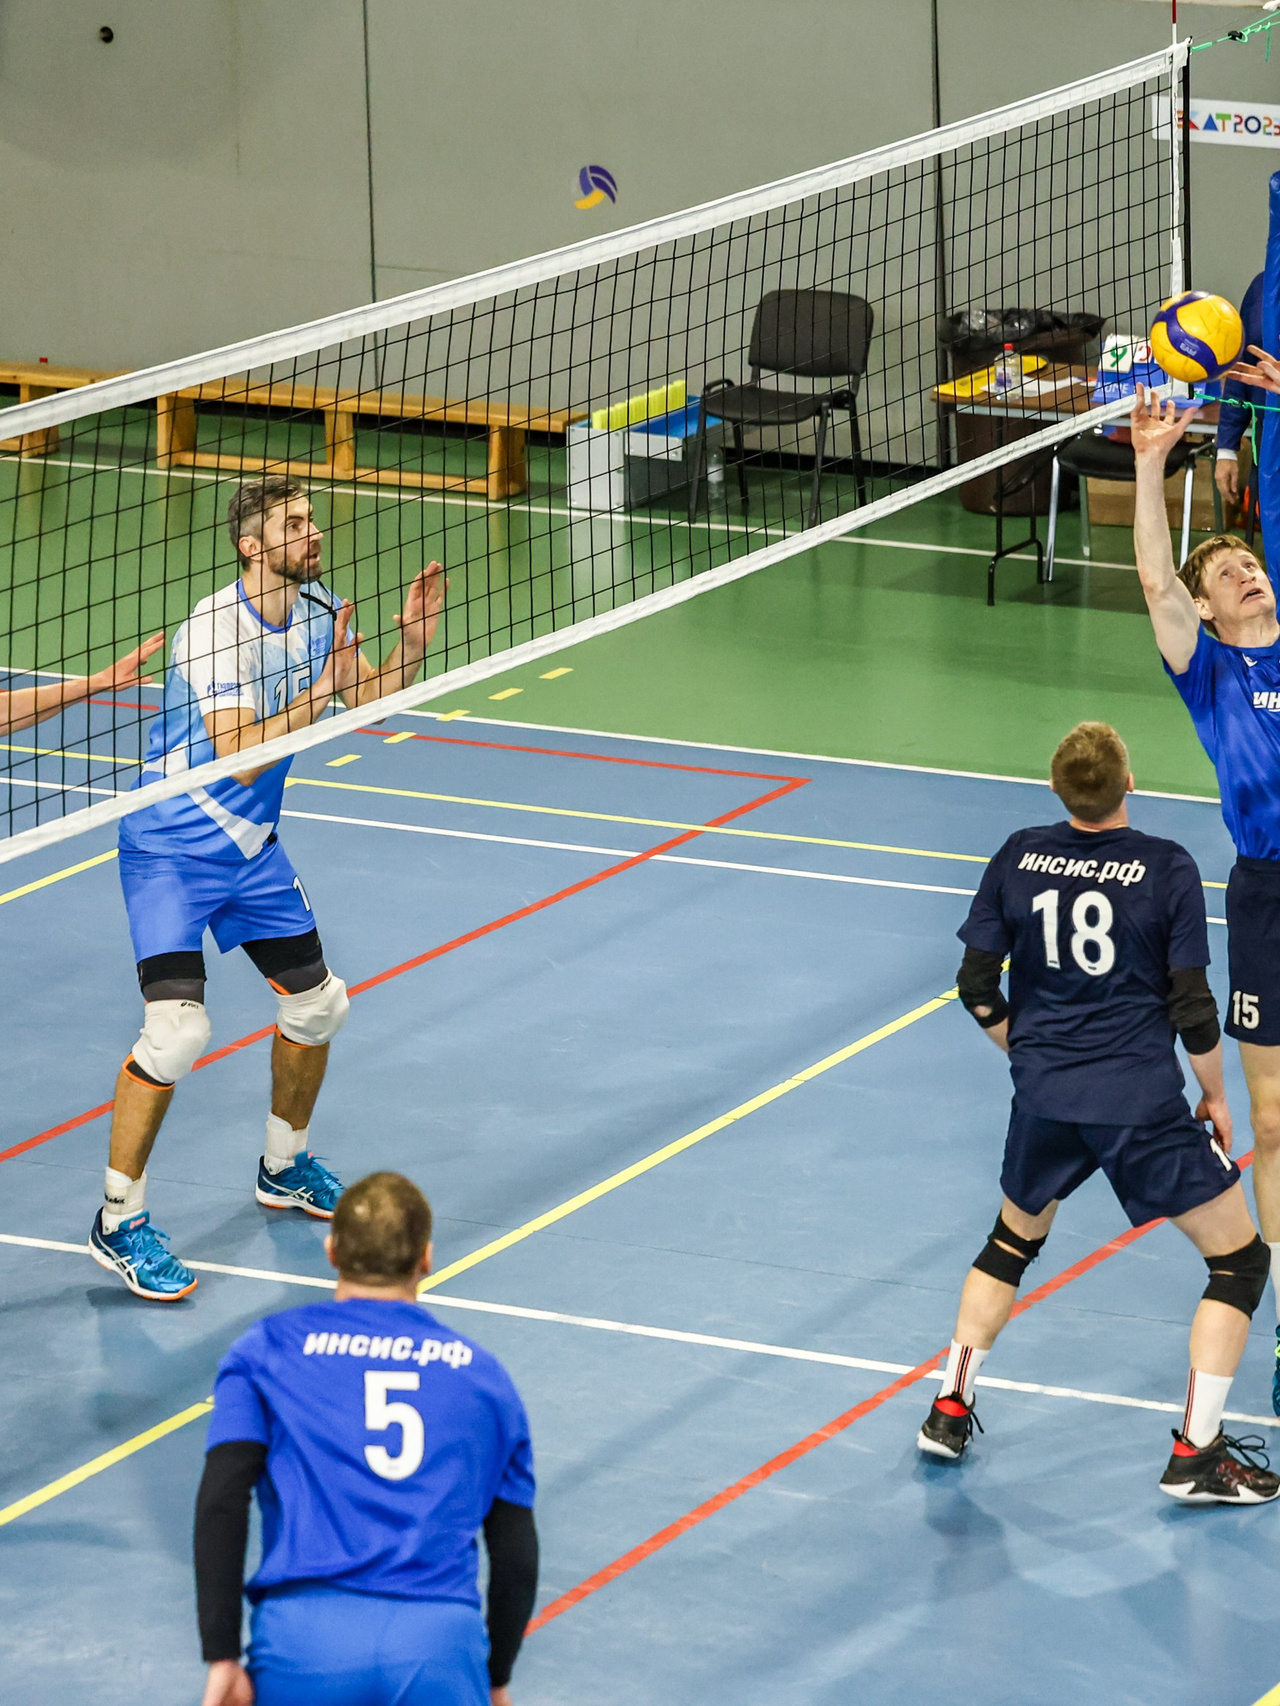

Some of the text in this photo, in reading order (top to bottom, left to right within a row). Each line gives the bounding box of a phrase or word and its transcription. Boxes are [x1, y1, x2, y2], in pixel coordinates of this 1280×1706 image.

[1032, 889, 1116, 976] 18
[1232, 990, 1260, 1030] 15
[364, 1370, 425, 1481] 5
